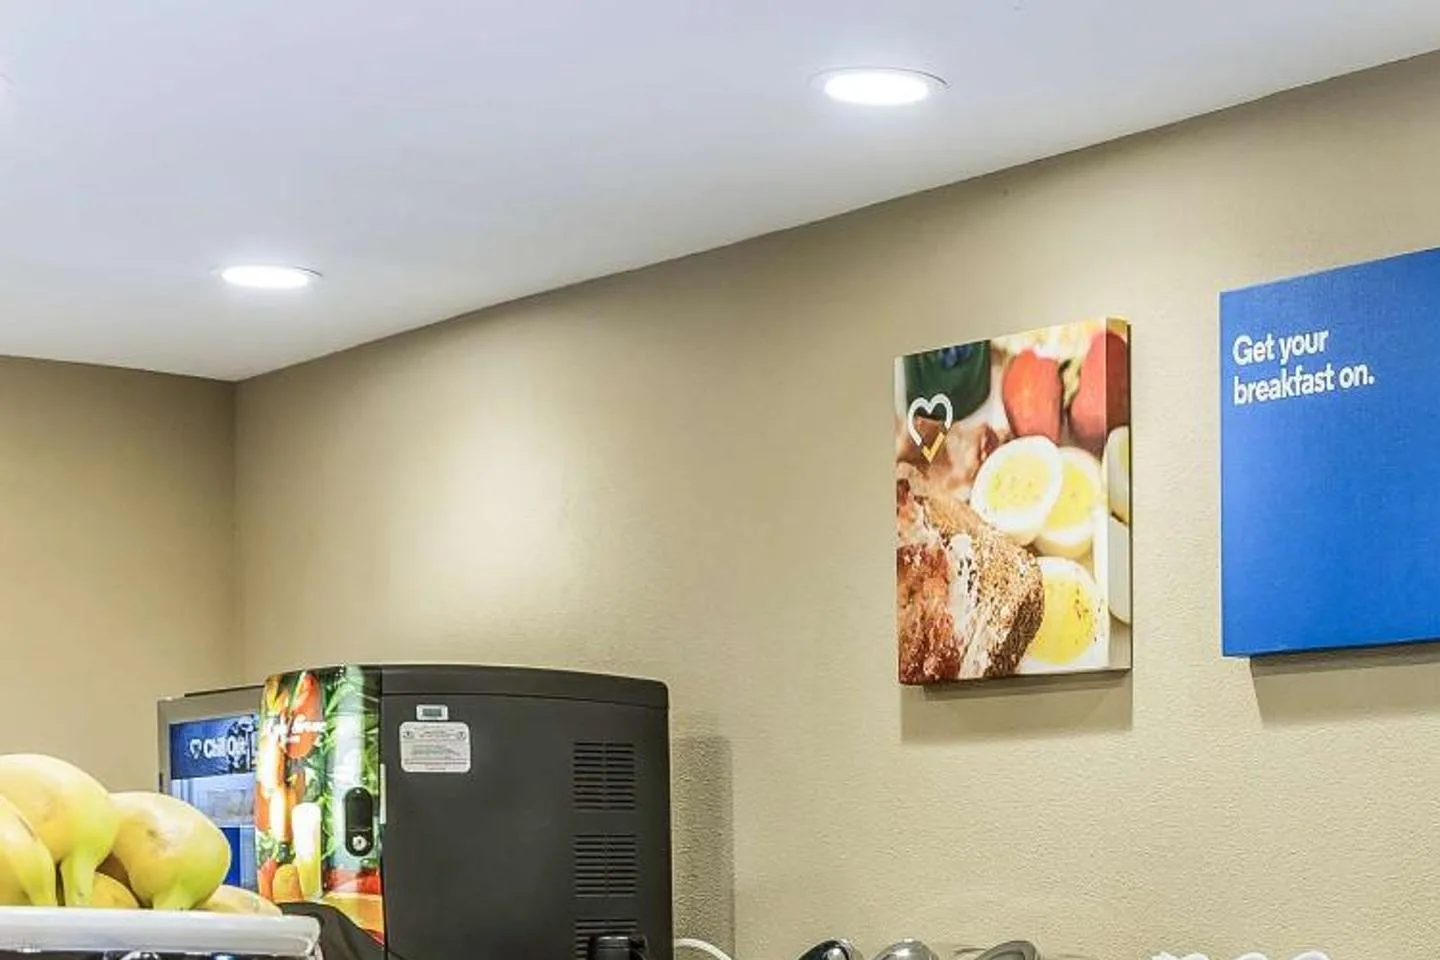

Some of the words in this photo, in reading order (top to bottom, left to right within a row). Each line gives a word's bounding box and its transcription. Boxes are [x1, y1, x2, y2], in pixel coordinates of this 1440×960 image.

[1232, 333, 1275, 366] Get
[1278, 329, 1329, 365] your
[1233, 363, 1335, 405] breakfast
[1339, 363, 1375, 389] on.
